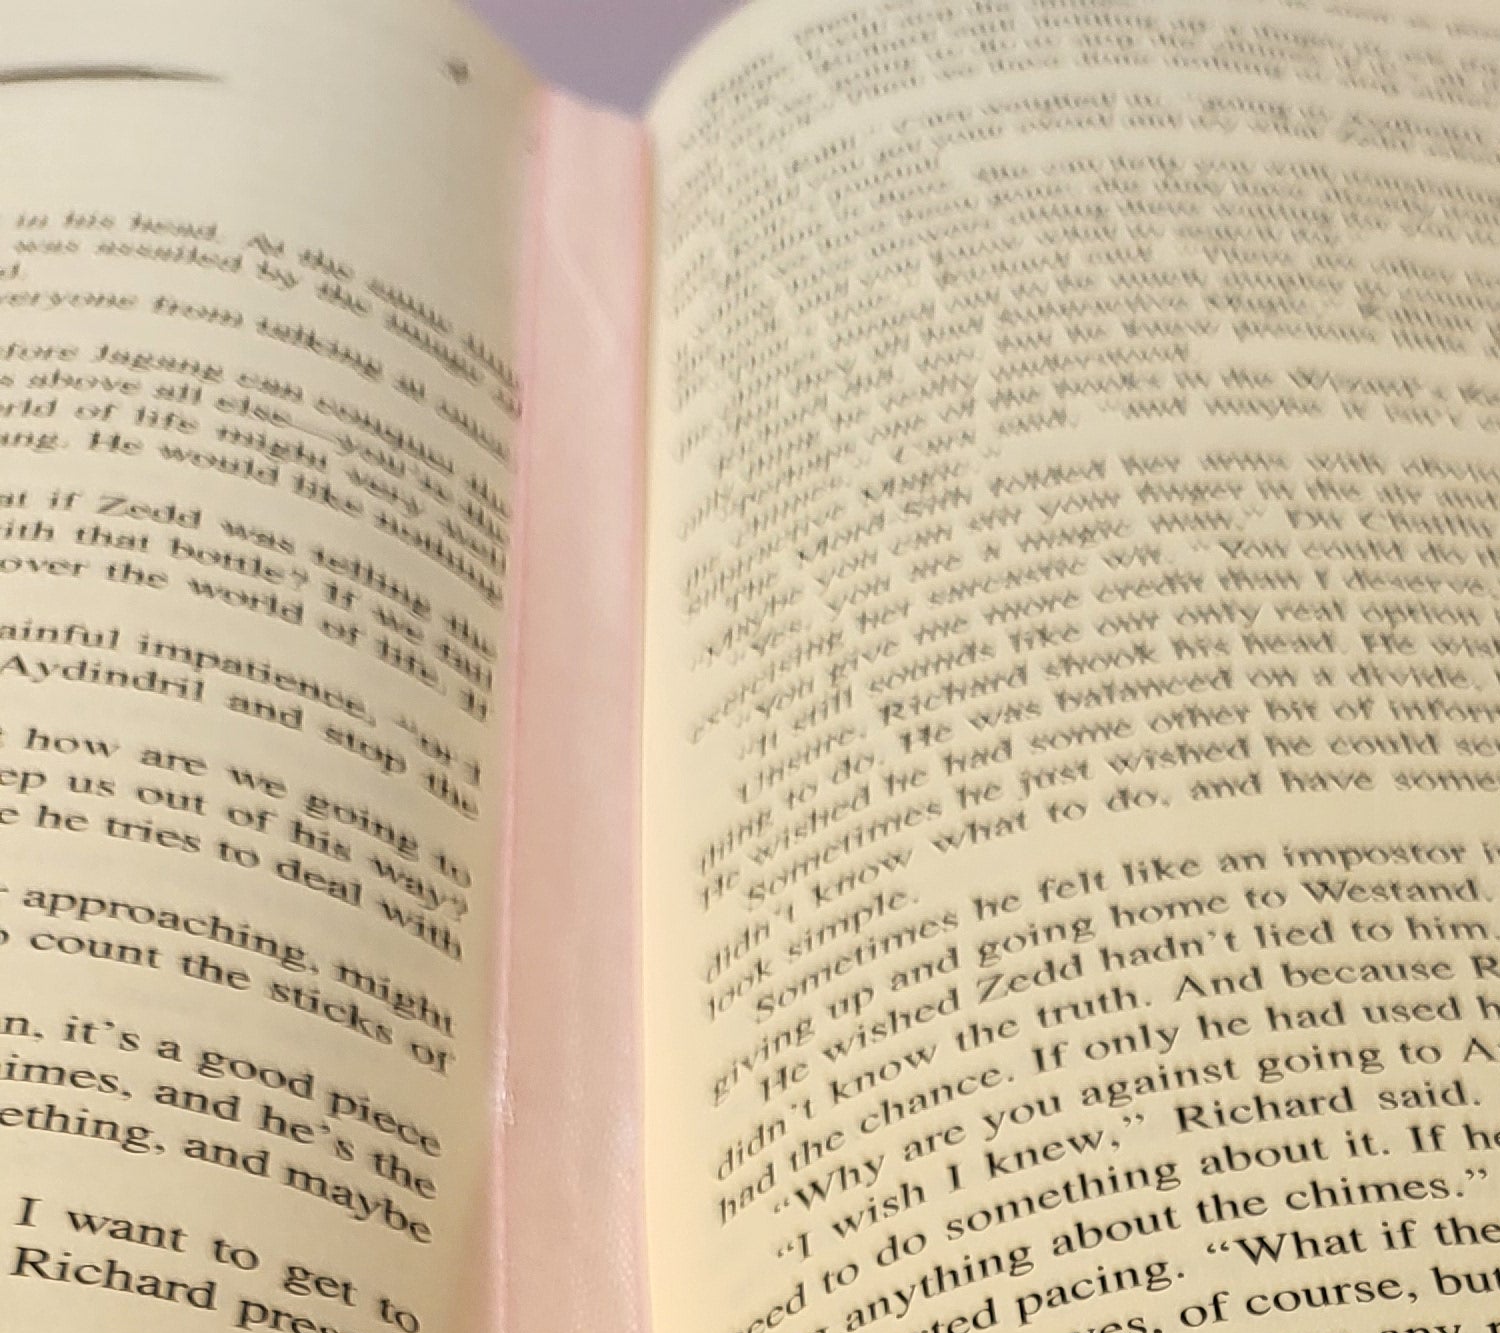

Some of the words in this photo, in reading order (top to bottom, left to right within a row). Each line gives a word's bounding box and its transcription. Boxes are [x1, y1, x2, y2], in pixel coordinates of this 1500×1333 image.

[1121, 857, 1200, 886] like
[1217, 851, 1267, 873] an
[1282, 842, 1467, 872] impostor
[29, 933, 160, 969] count
[181, 954, 251, 991] the
[269, 981, 393, 1045] sticks
[409, 1041, 449, 1075] of
[335, 963, 454, 1038] might
[63, 1015, 140, 1052] it’s
[155, 1039, 182, 1063] a
[197, 1050, 315, 1101] good
[327, 1090, 441, 1158] piece
[153, 1085, 241, 1122] and
[258, 1103, 354, 1162] he’s
[371, 1151, 436, 1200] the
[183, 1138, 271, 1178] and
[283, 1166, 431, 1244] maybe
[777, 1232, 811, 1259] “I
[831, 1182, 926, 1239] wish
[946, 1163, 961, 1191] I
[984, 1113, 1145, 1179] knew,”
[1174, 1084, 1355, 1133] Richard
[1378, 1079, 1481, 1110] said.
[15, 1196, 42, 1227] I
[66, 1210, 188, 1253] want
[212, 1238, 259, 1271] to
[282, 1265, 356, 1307] get
[821, 1263, 859, 1295] to
[876, 1233, 927, 1267] do
[946, 1161, 1181, 1241] something
[1200, 1137, 1327, 1176] about
[1345, 1129, 1390, 1157] it.
[1409, 1123, 1446, 1153] If
[846, 1246, 1035, 1333] anything
[1052, 1206, 1179, 1257] about
[1195, 1193, 1268, 1224] the
[1285, 1167, 1488, 1211] chimes.”
[9, 1246, 217, 1311] Richard
[1015, 1261, 1185, 1326] pacing.
[1206, 1227, 1367, 1266] “What
[1381, 1219, 1417, 1250] if
[1179, 1290, 1230, 1328] of
[1245, 1278, 1418, 1316] course,
